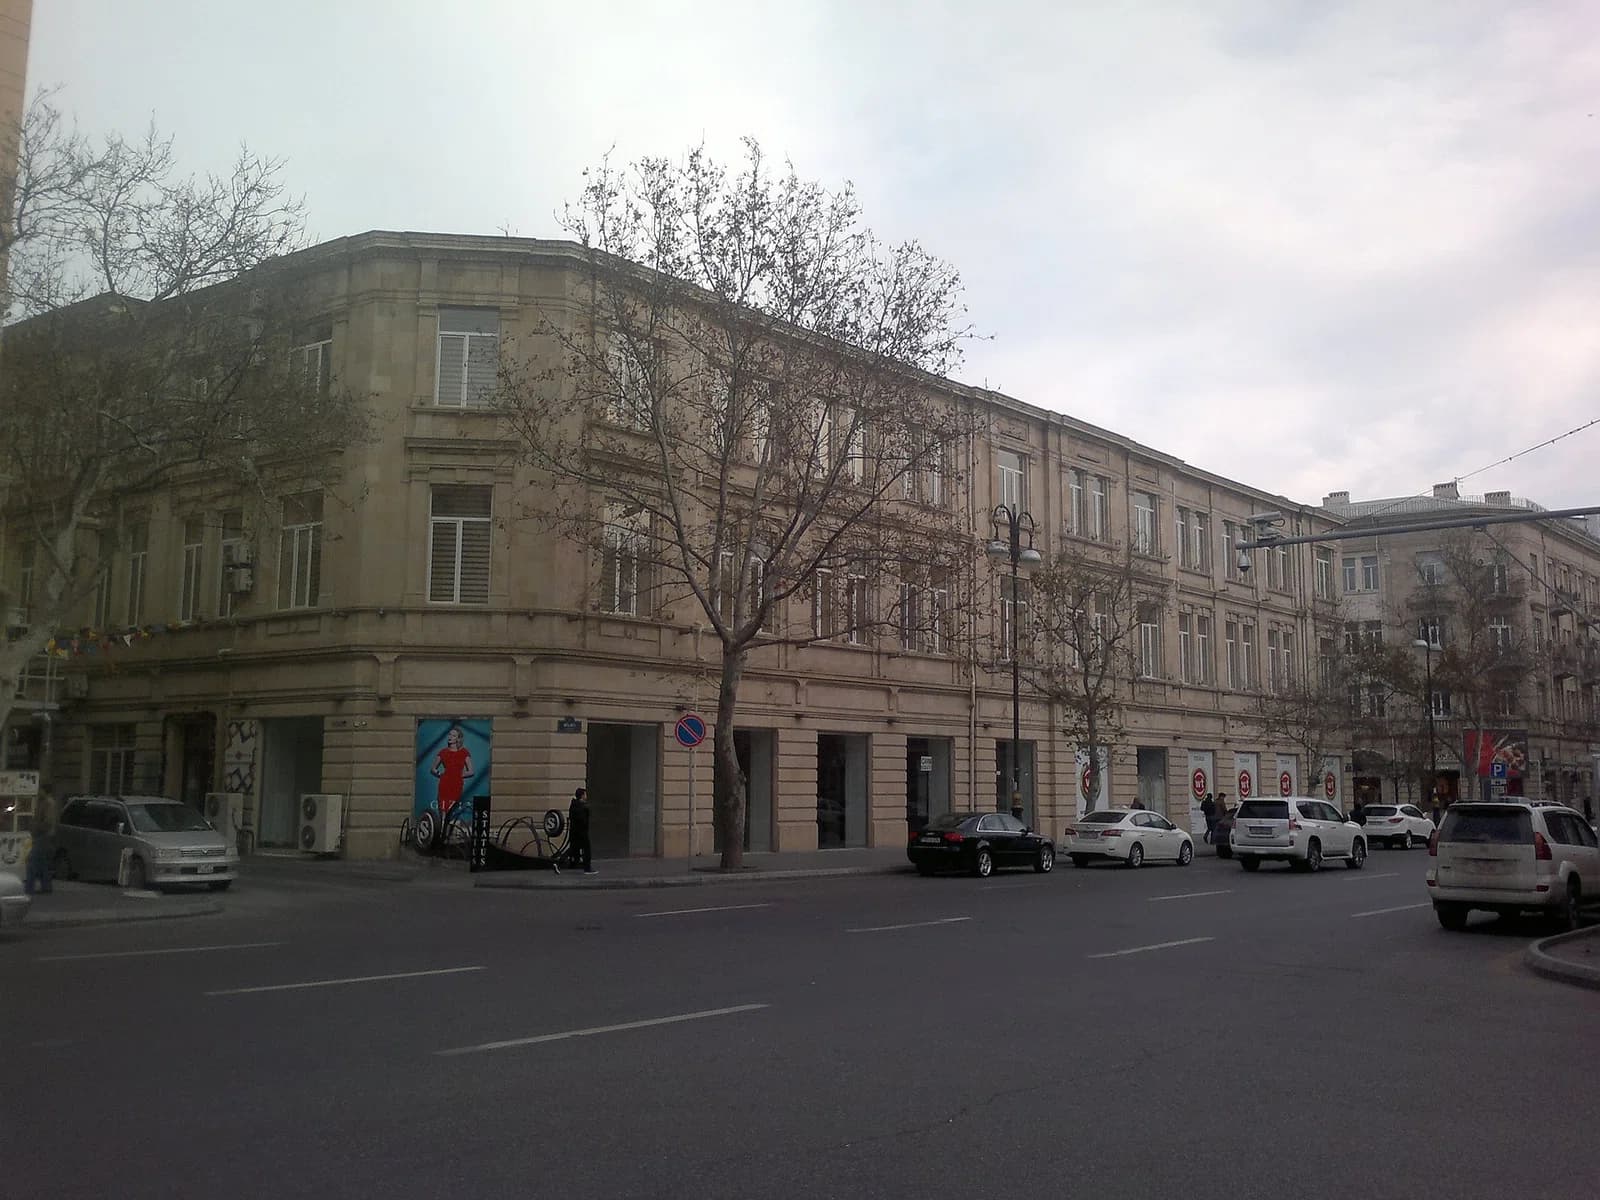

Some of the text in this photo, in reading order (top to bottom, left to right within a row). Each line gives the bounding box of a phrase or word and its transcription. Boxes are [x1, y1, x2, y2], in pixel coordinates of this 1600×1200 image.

[1493, 764, 1503, 777] P
[420, 820, 429, 839] S
[547, 817, 556, 829] S
[480, 809, 489, 866] STATUS
